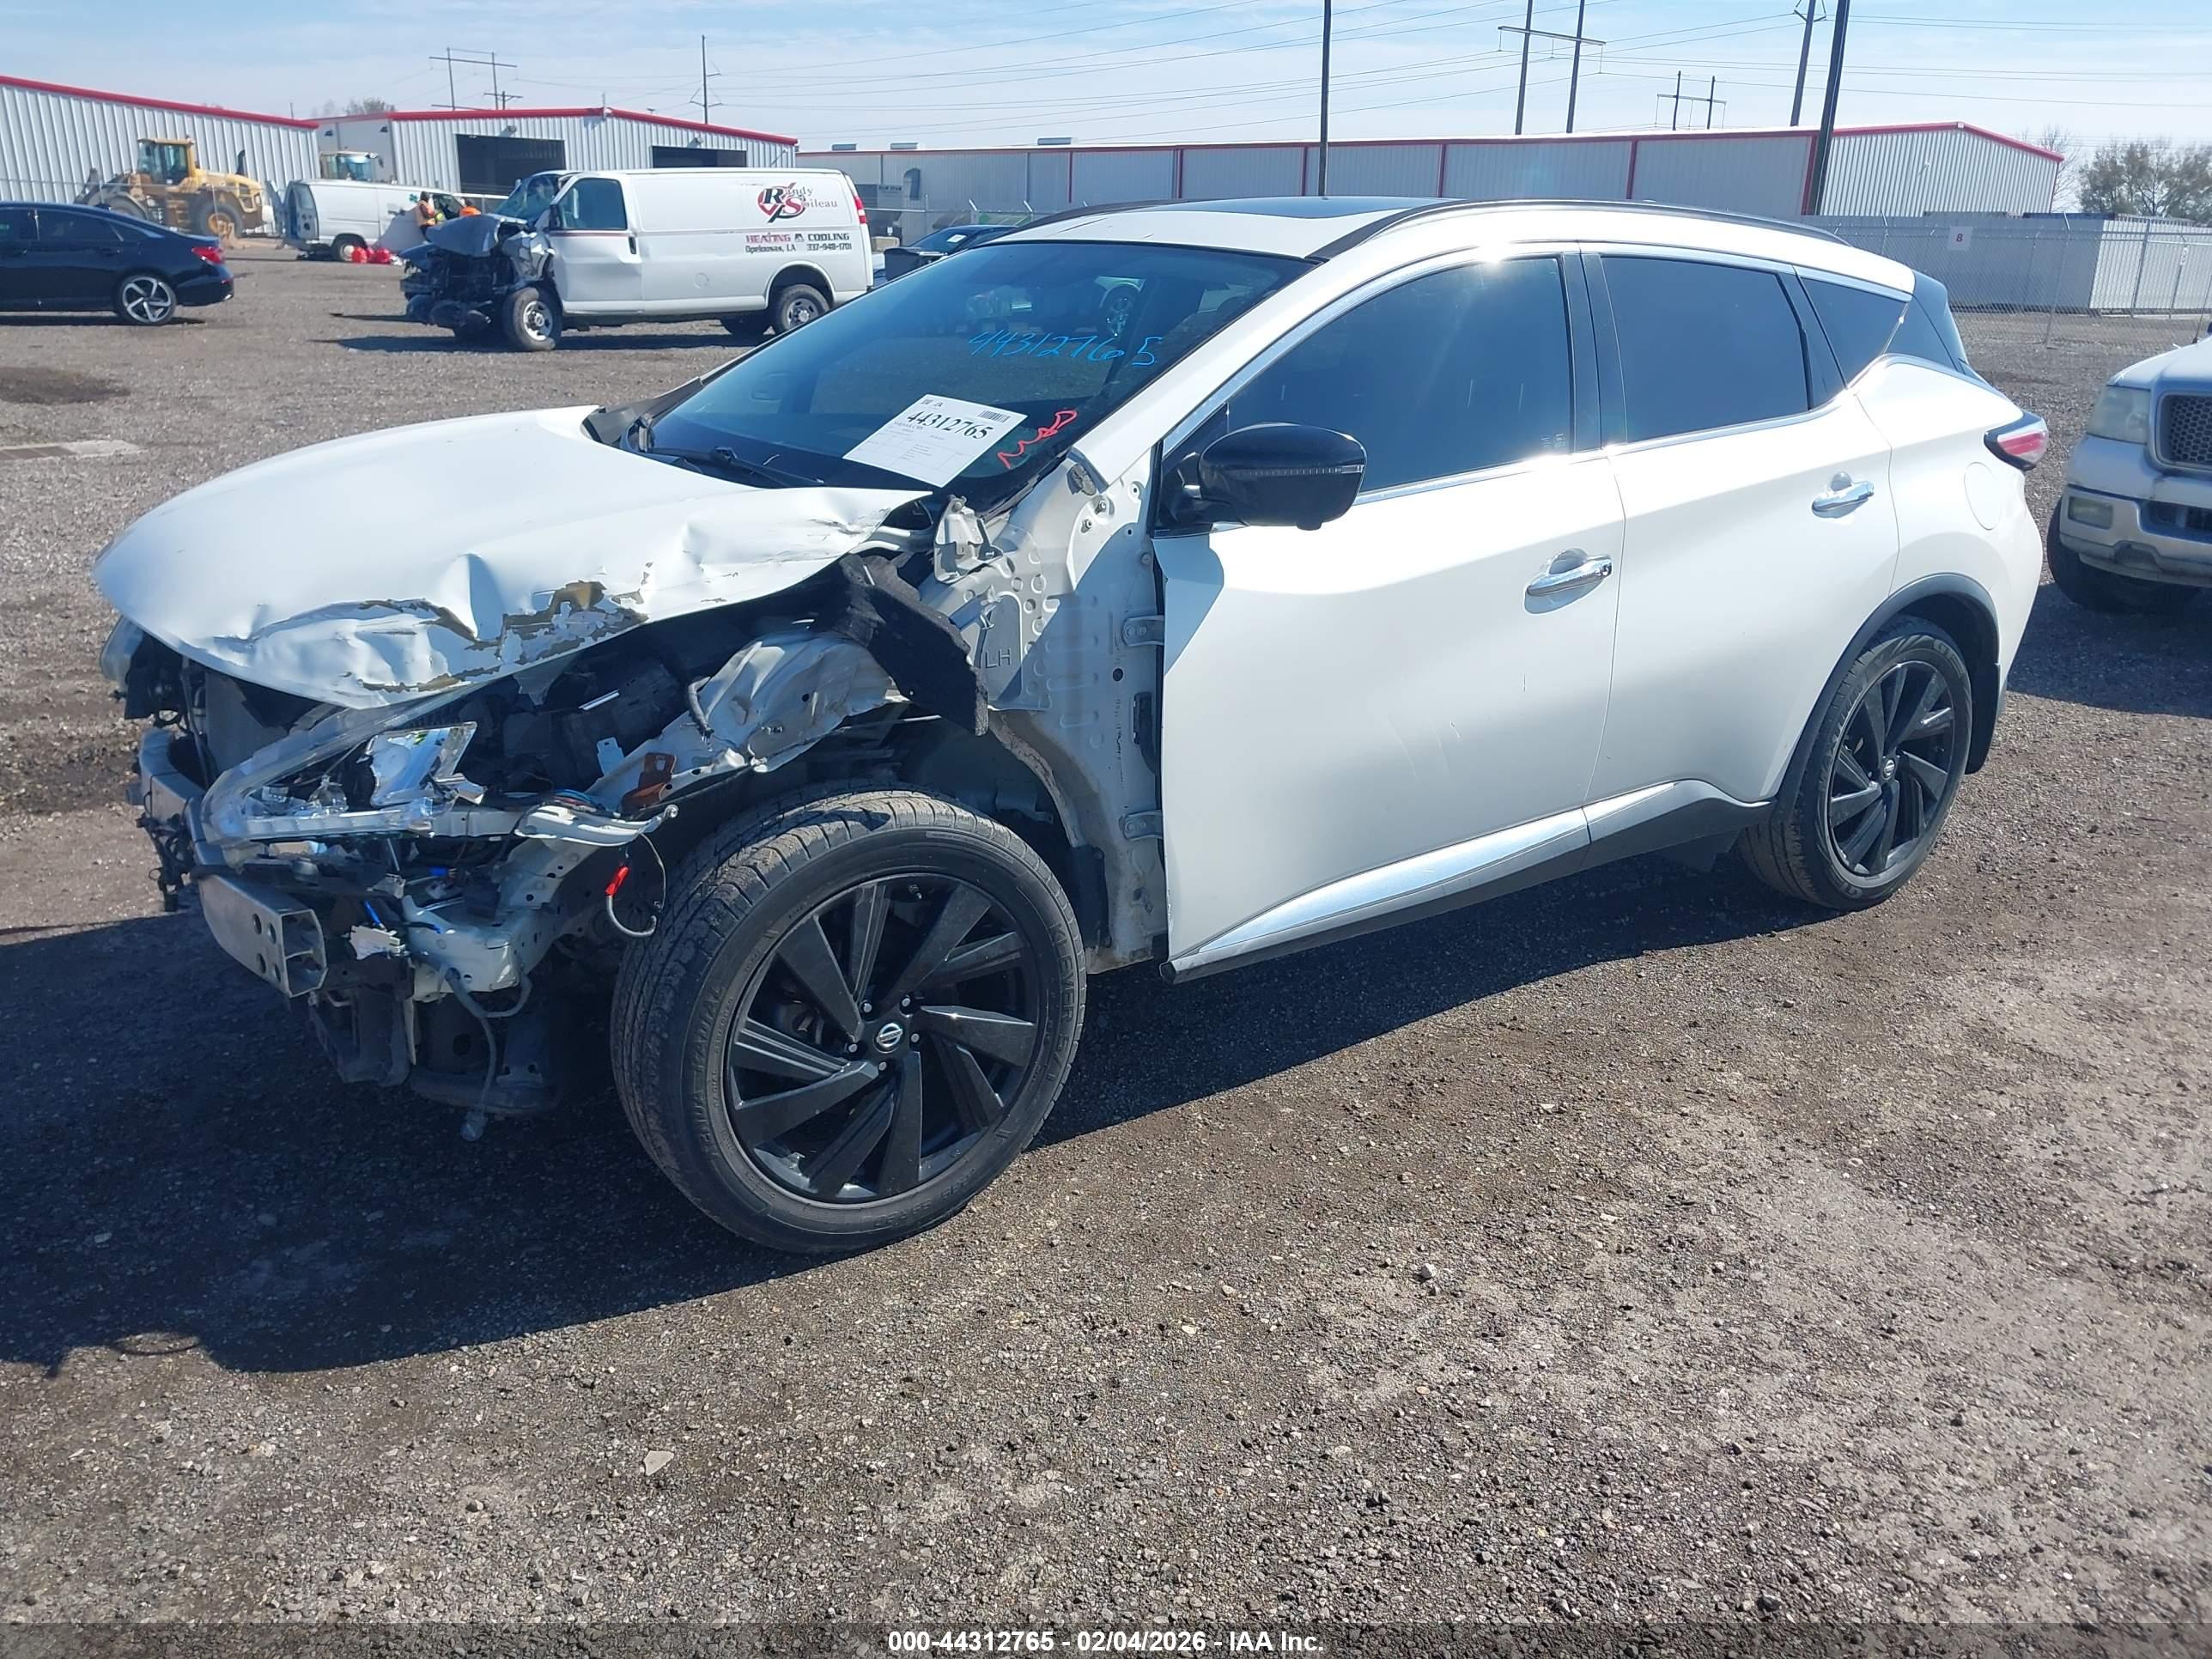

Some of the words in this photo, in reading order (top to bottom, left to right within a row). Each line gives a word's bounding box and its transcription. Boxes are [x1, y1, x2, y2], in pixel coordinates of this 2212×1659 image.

[745, 233, 791, 243] HEATING
[807, 233, 850, 241] COOLING
[907, 410, 994, 440] 44312765
[985, 647, 1011, 669] LH
